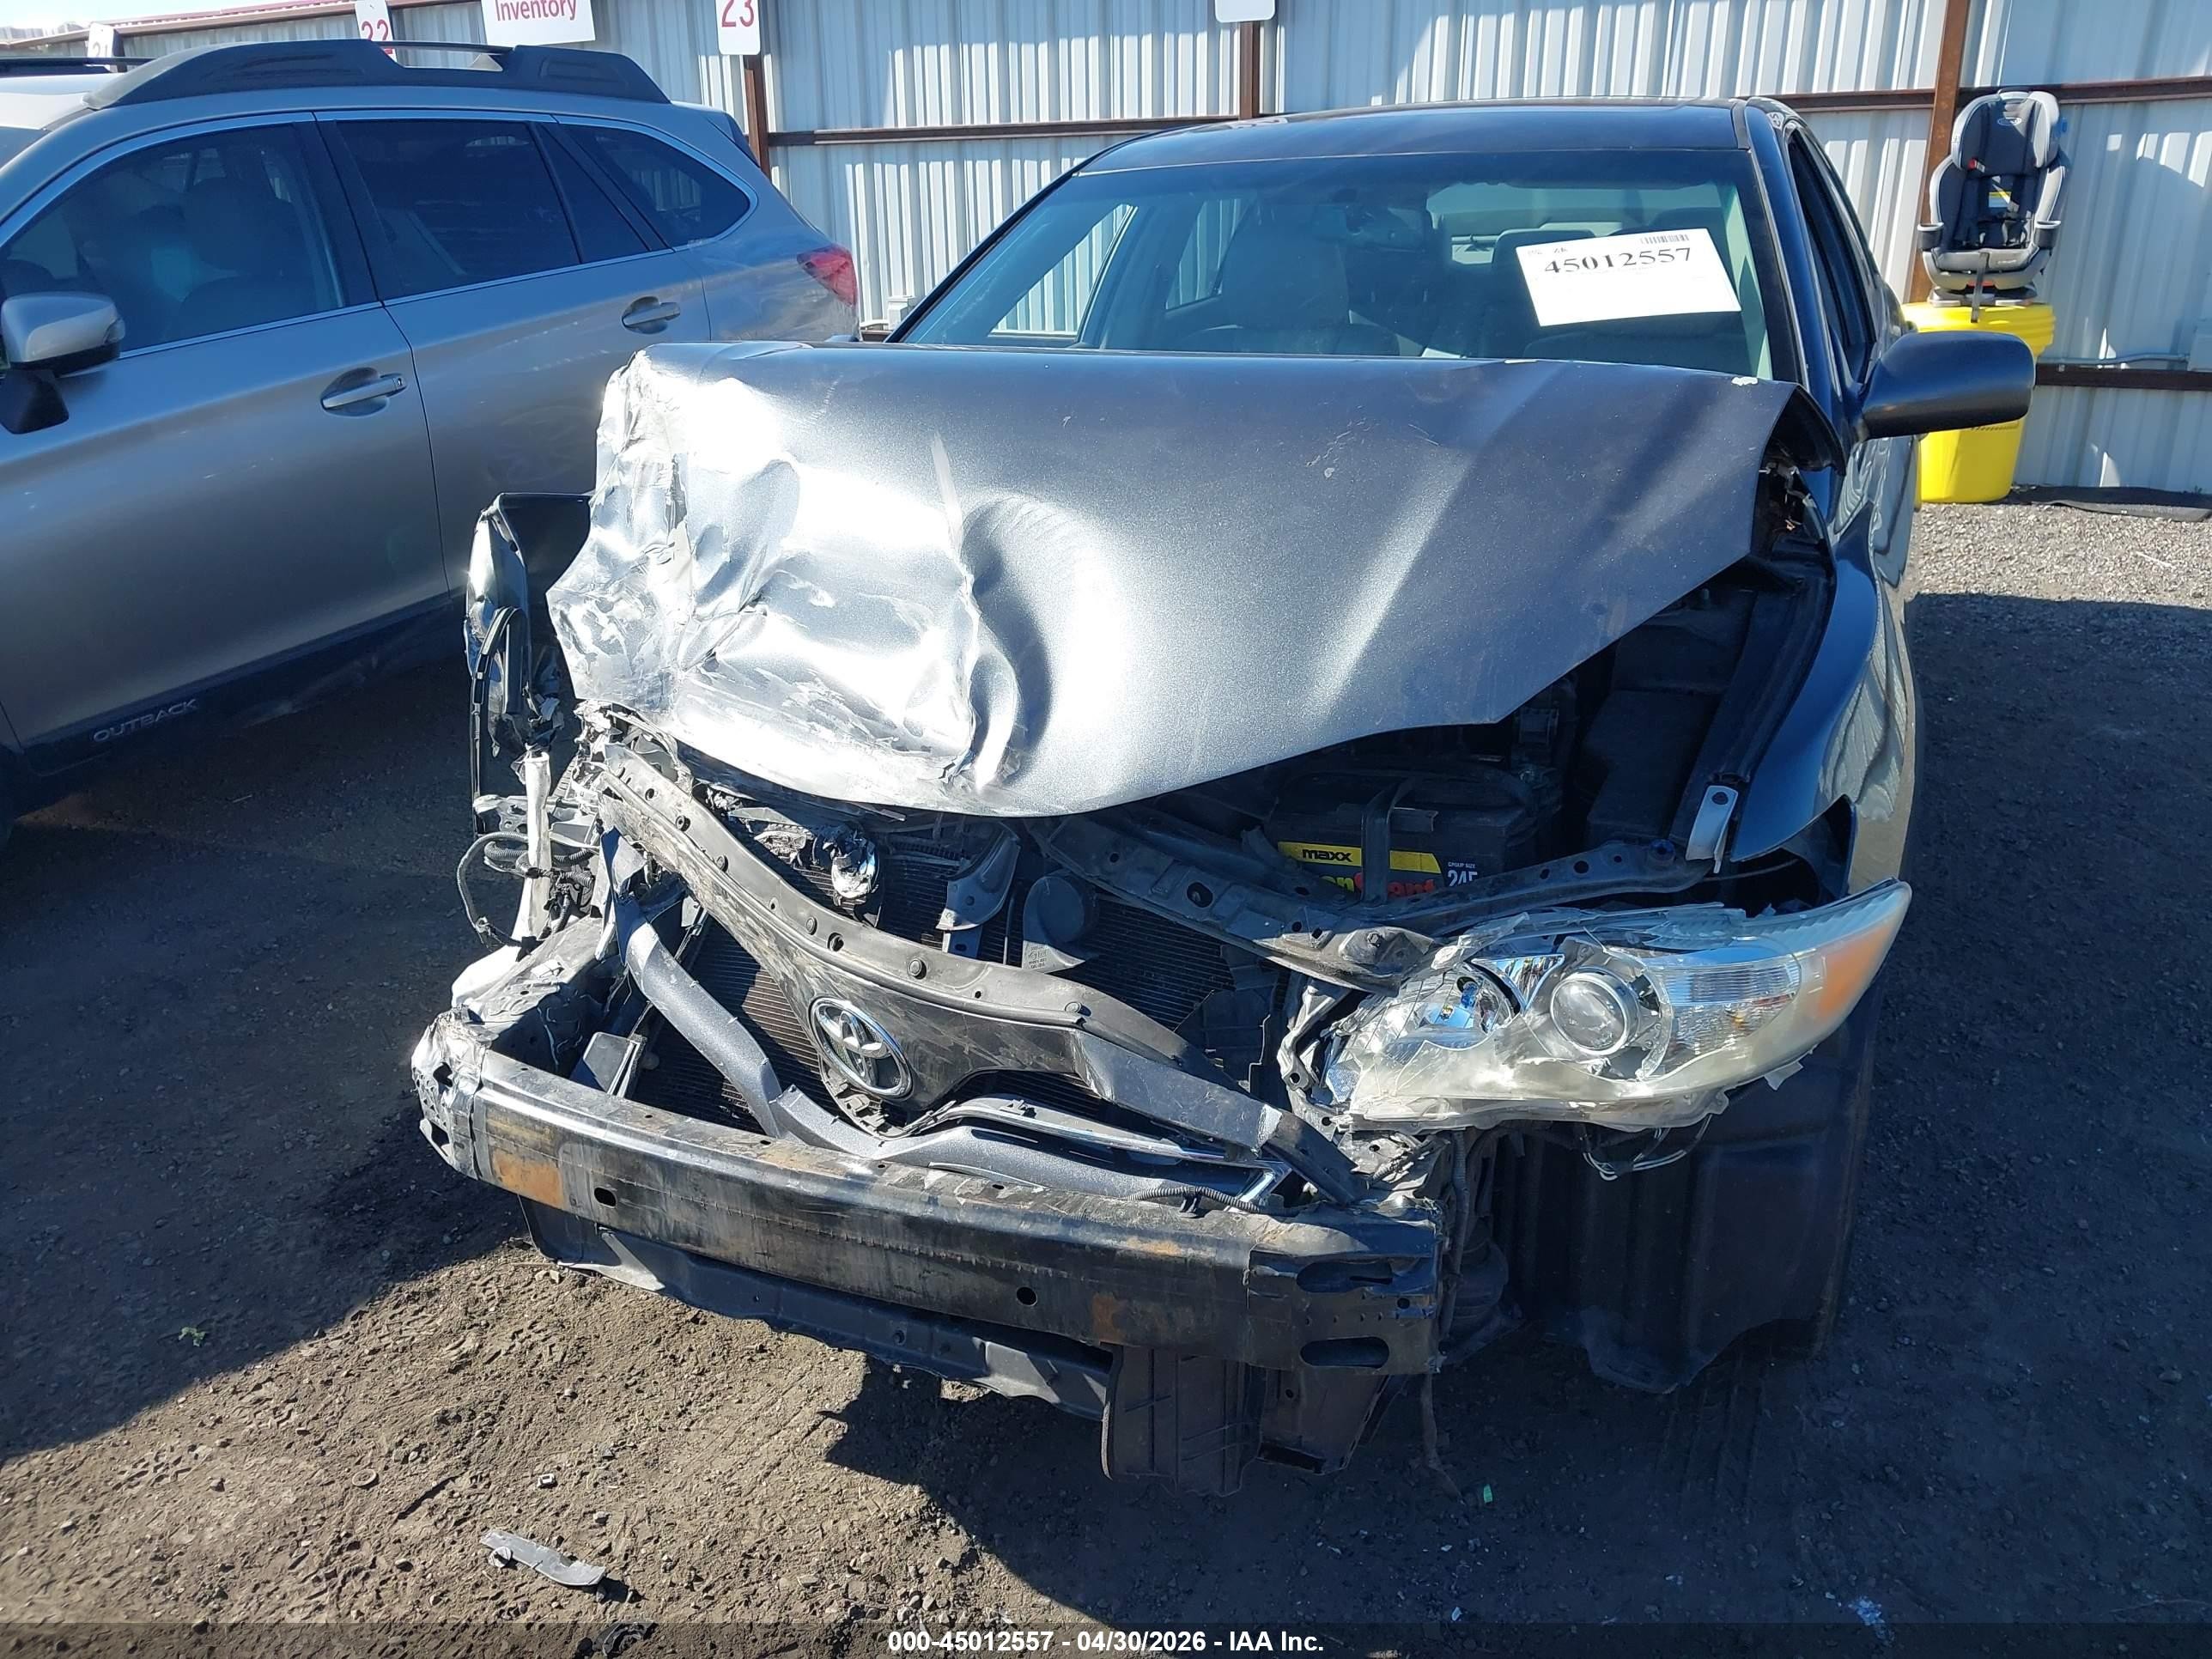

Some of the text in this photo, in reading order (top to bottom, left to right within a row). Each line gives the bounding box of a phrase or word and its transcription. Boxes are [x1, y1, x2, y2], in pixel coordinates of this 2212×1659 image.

[495, 0, 576, 21] Inventory
[722, 0, 754, 27] 23
[362, 20, 392, 54] 22
[1544, 247, 1691, 274] 45012557
[93, 698, 197, 742] OUTBACK
[1302, 848, 1352, 862] maxx
